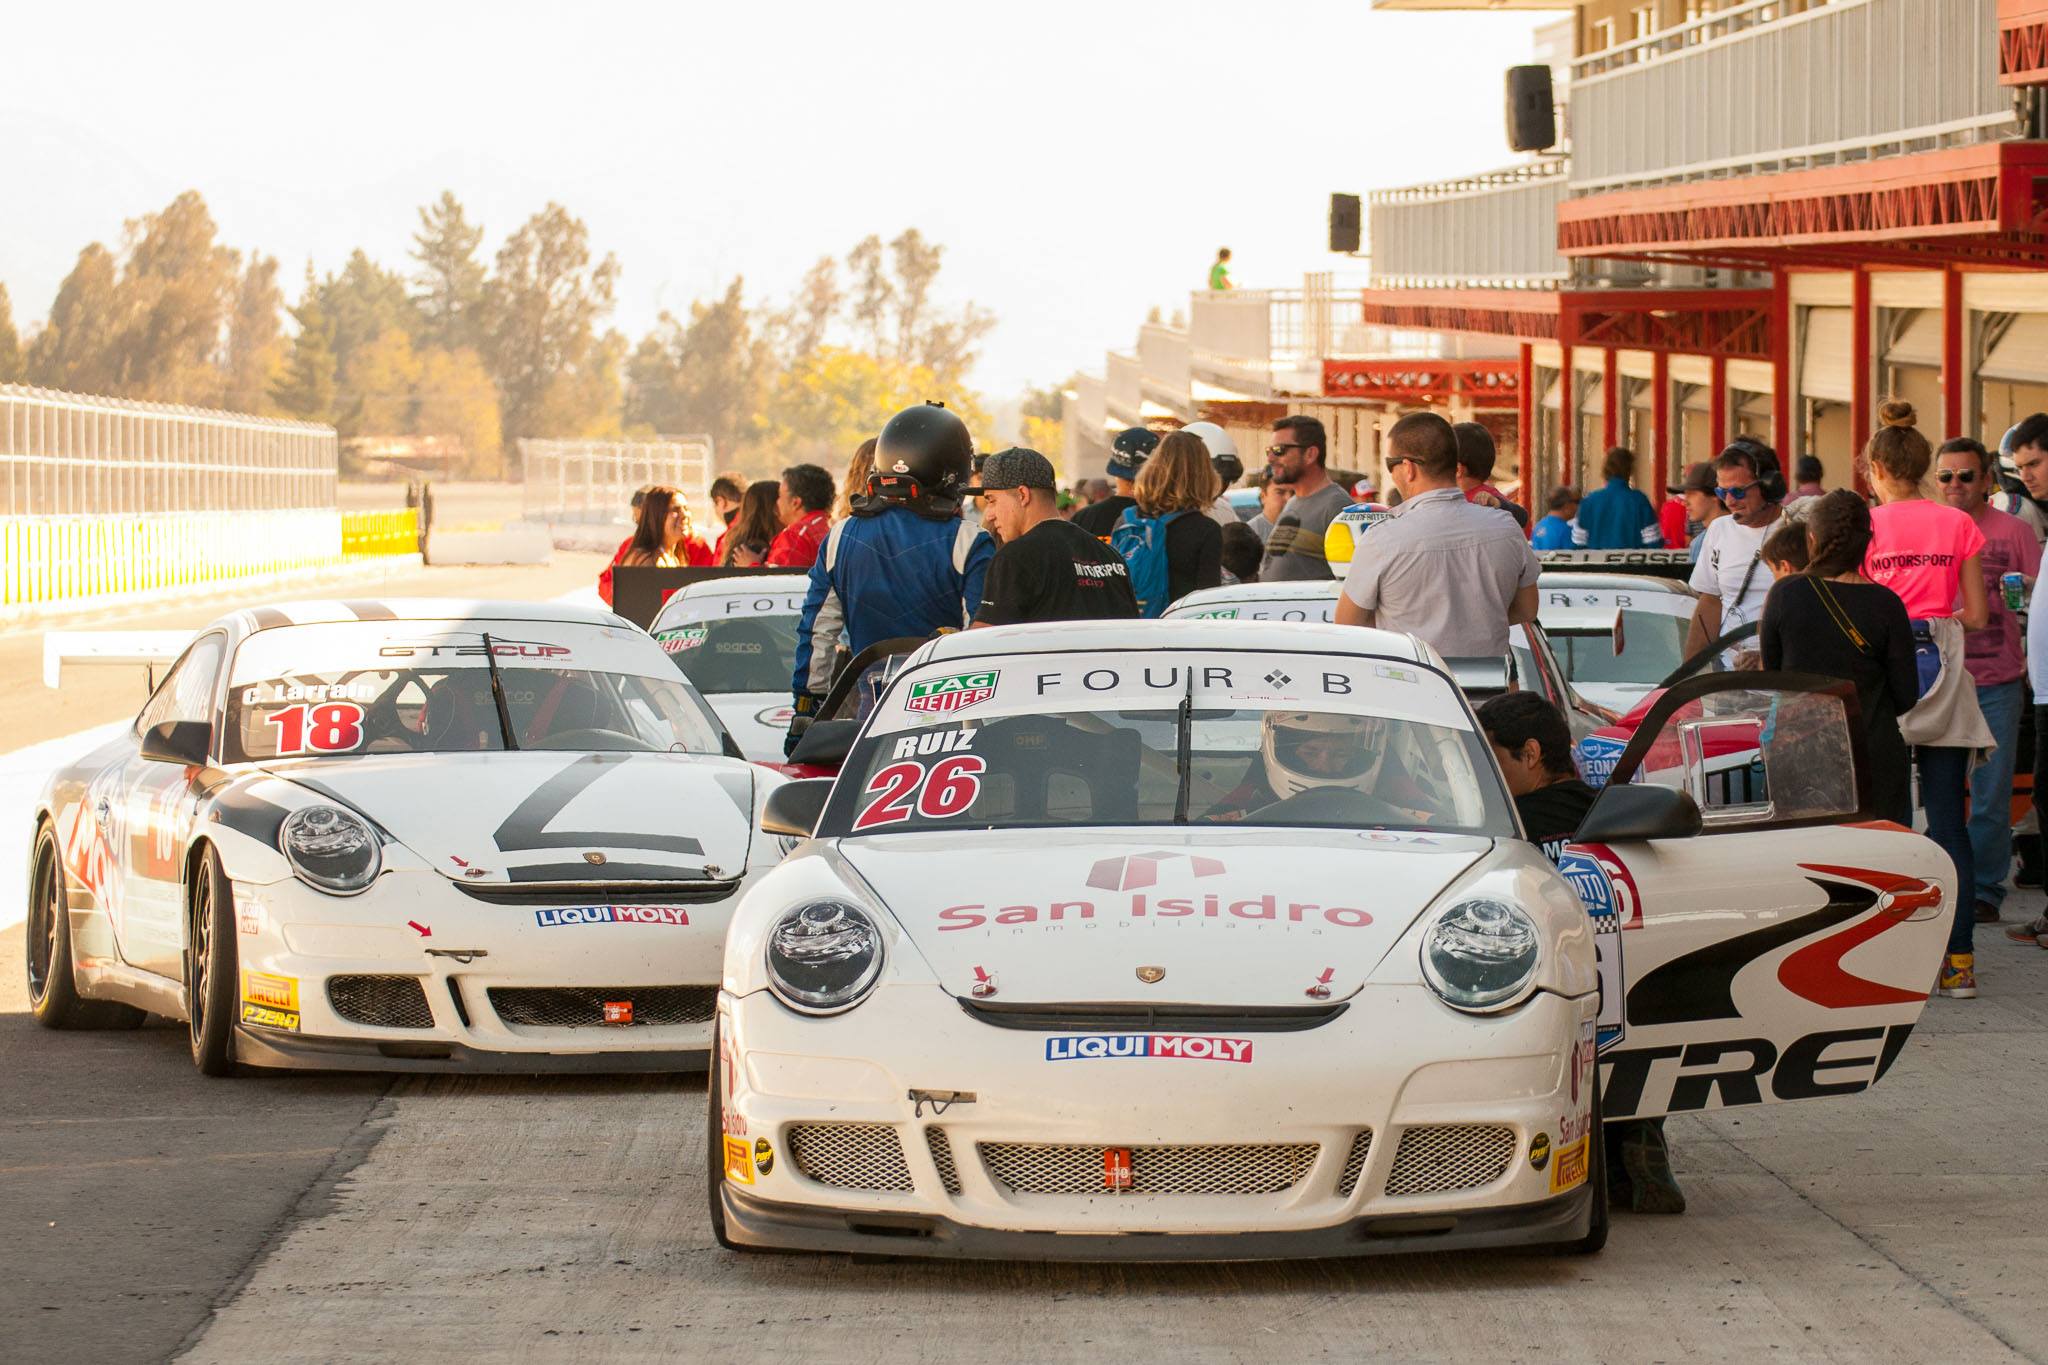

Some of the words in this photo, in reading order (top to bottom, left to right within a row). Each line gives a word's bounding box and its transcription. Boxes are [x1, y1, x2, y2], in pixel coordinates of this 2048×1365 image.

[1871, 553, 1955, 571] MOTORSPORT
[274, 682, 375, 704] Larrain
[919, 674, 990, 695] TAG
[1037, 667, 1233, 696] FOUR
[1322, 671, 1352, 695] B
[911, 689, 989, 712] HEUER
[264, 701, 366, 756] 18
[892, 728, 978, 760] RUIZ
[852, 754, 987, 831] 26
[538, 906, 611, 926] LIQUI
[615, 907, 685, 925] MOLY
[938, 901, 1095, 931] San
[1132, 894, 1374, 928] Isidro
[256, 1007, 300, 1028] ZERO
[1050, 1036, 1145, 1059] LIQUI
[1153, 1036, 1252, 1061] MOLY
[1556, 1144, 1586, 1187] PIRELLI
